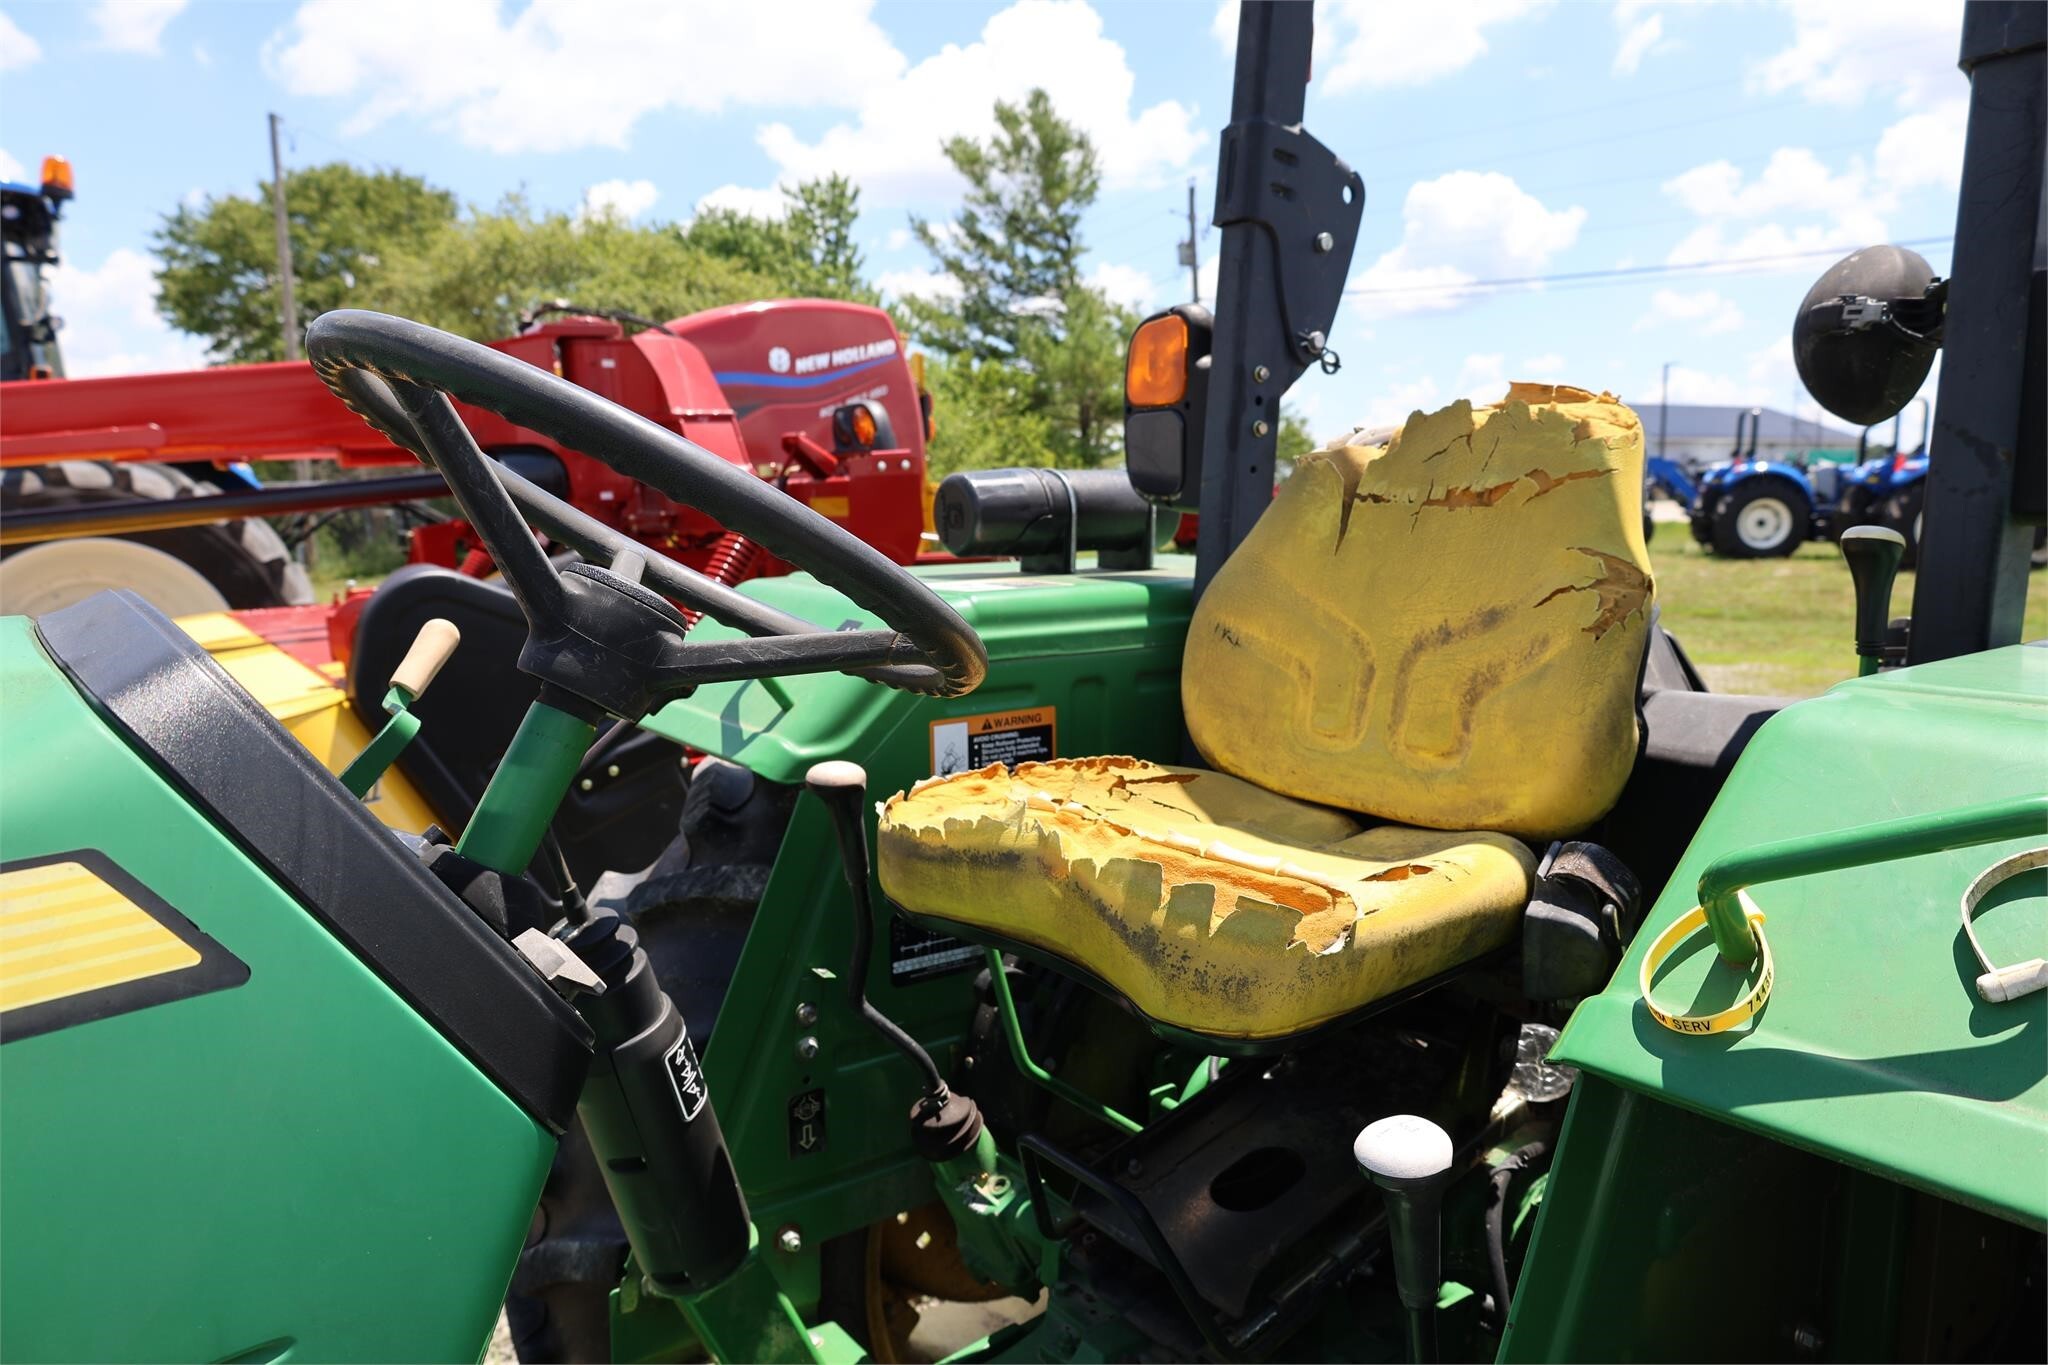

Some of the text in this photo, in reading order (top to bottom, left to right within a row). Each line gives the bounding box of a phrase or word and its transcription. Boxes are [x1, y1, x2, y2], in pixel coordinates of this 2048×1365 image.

[795, 338, 896, 374] NEW HOLLAND
[994, 713, 1041, 727] WARNING
[1672, 1018, 1711, 1032] SERV
